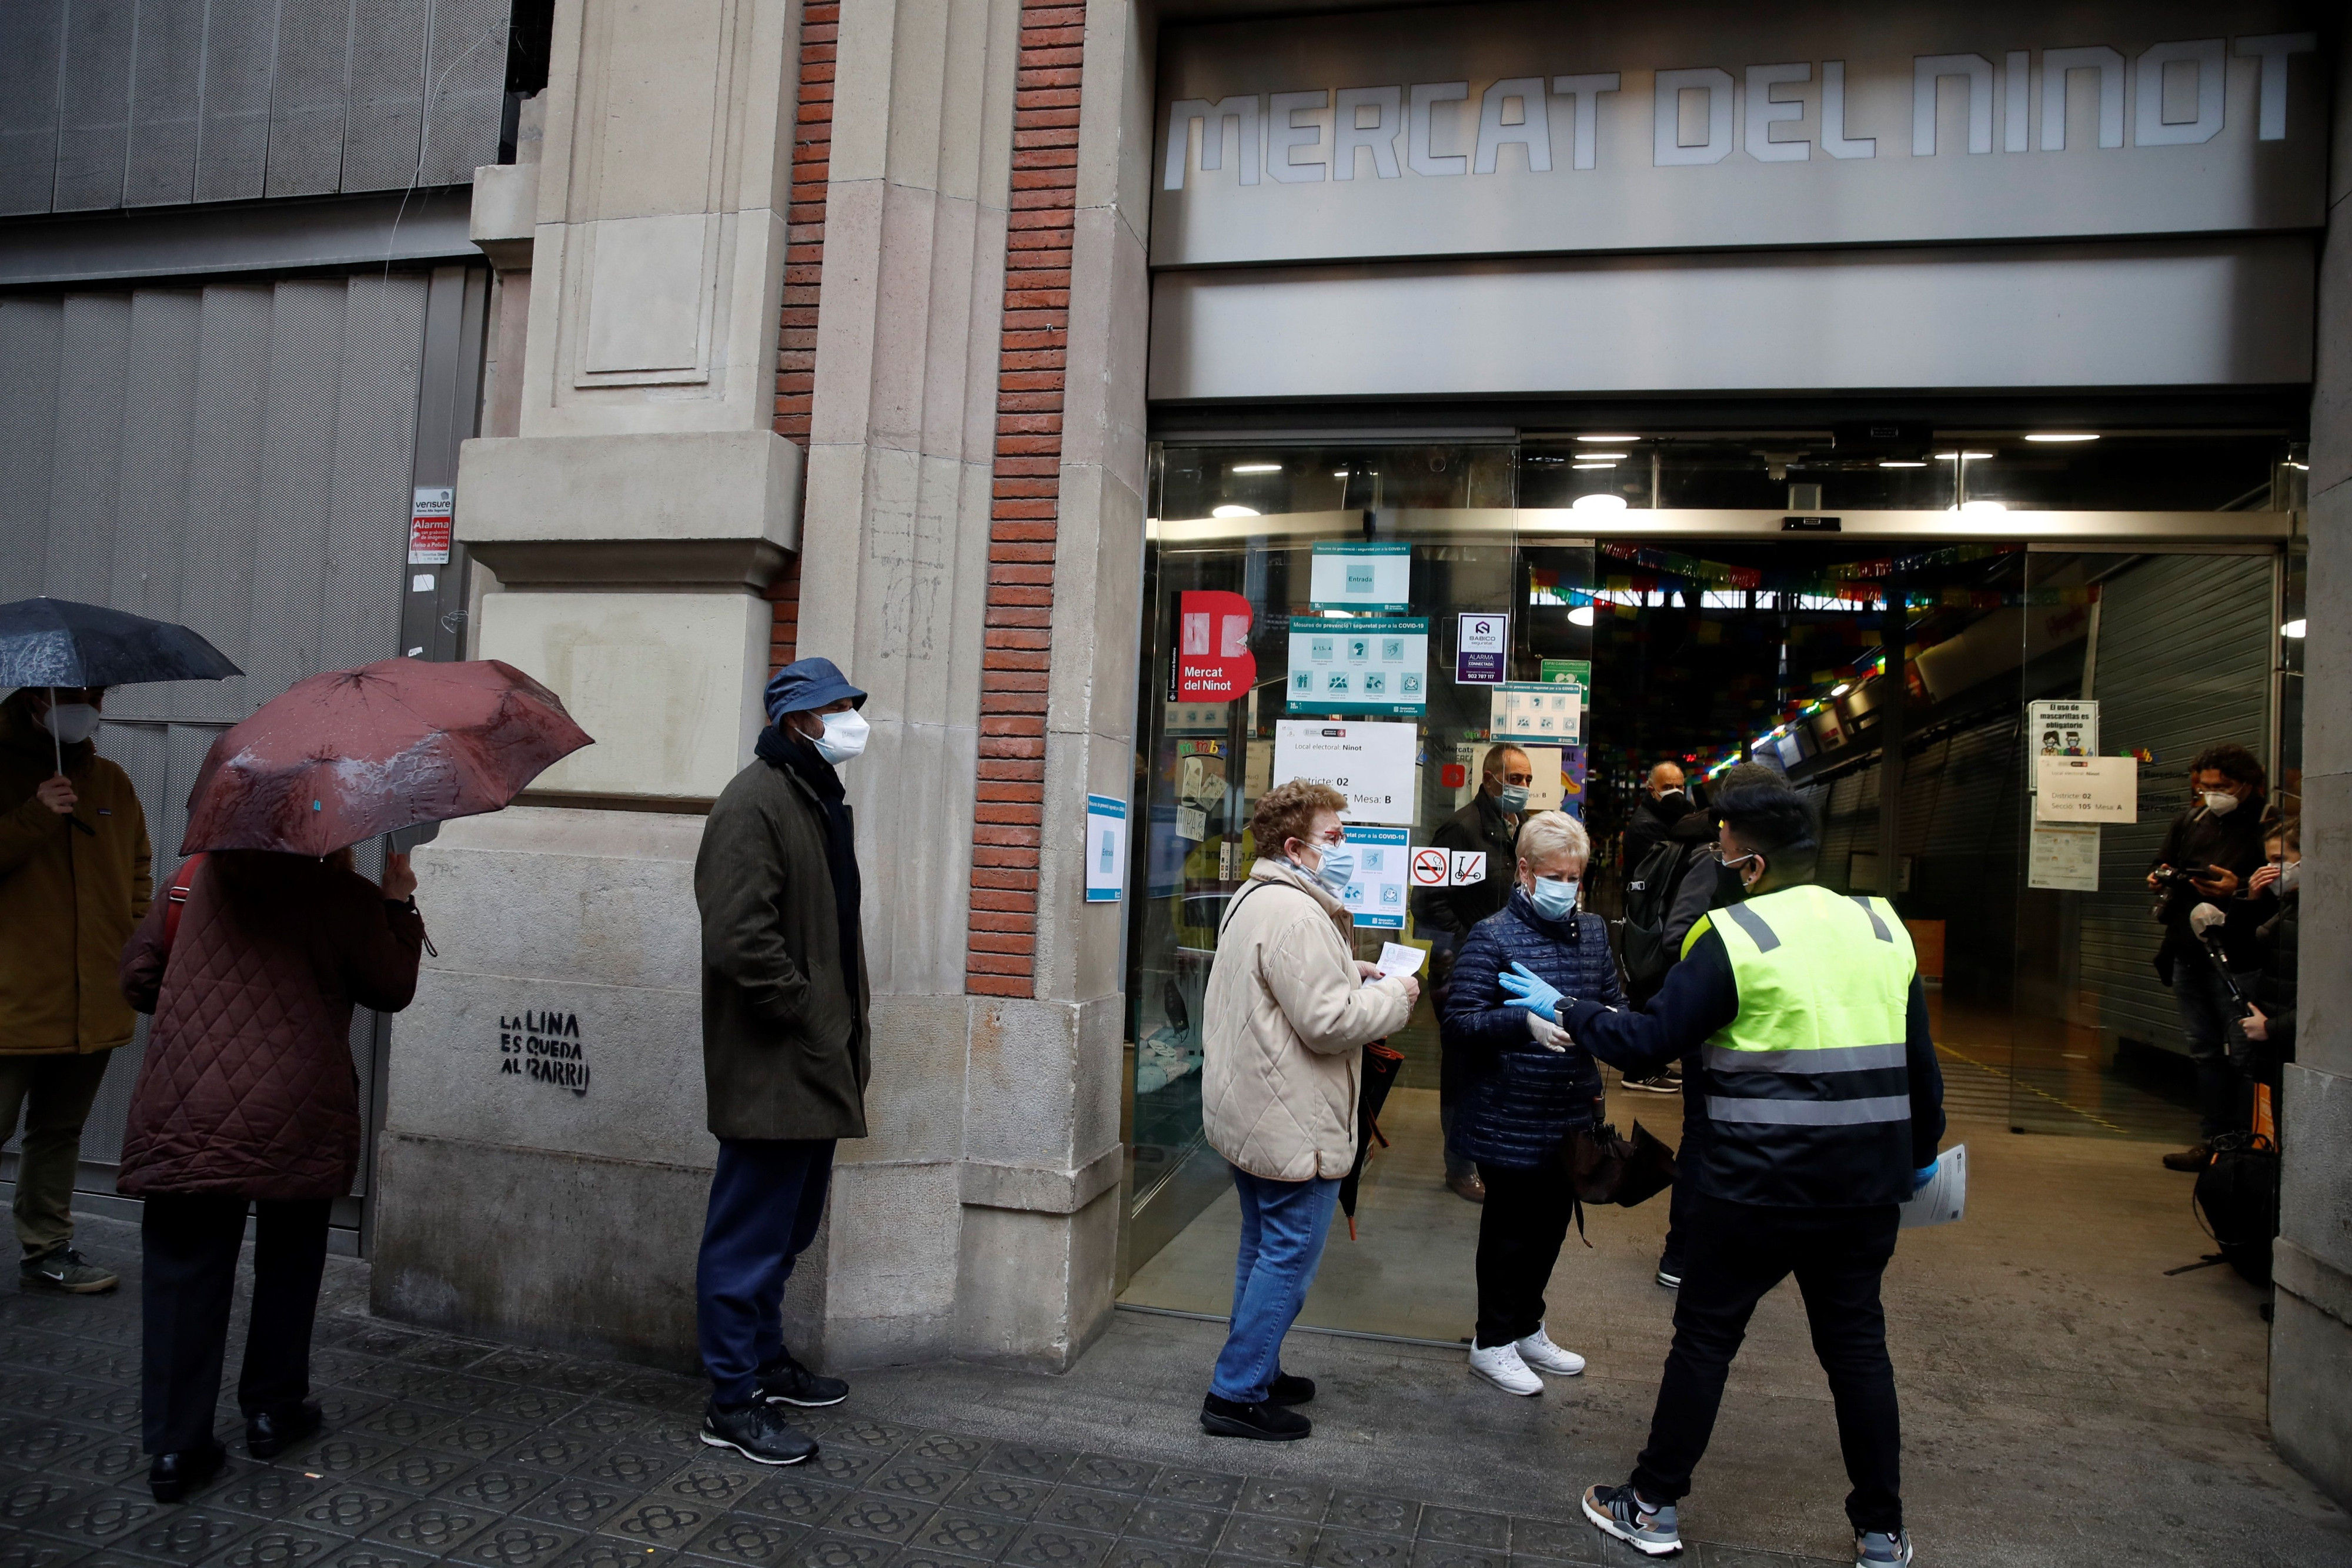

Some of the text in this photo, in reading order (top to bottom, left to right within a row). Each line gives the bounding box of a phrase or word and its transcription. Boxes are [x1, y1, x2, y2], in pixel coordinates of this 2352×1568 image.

[1164, 32, 2317, 191] MERCAT DEL NINOT
[413, 519, 449, 529] Alarma
[1184, 666, 1222, 677] Mercat
[1184, 680, 1231, 690] del Ninot
[1336, 778, 1348, 786] 02
[1354, 794, 1381, 804] Mesa:
[1102, 848, 1113, 857] Entrada
[501, 1009, 579, 1038] LA LINA
[502, 1034, 582, 1060] ES QUEDA
[502, 1058, 583, 1086] AL BARRI
